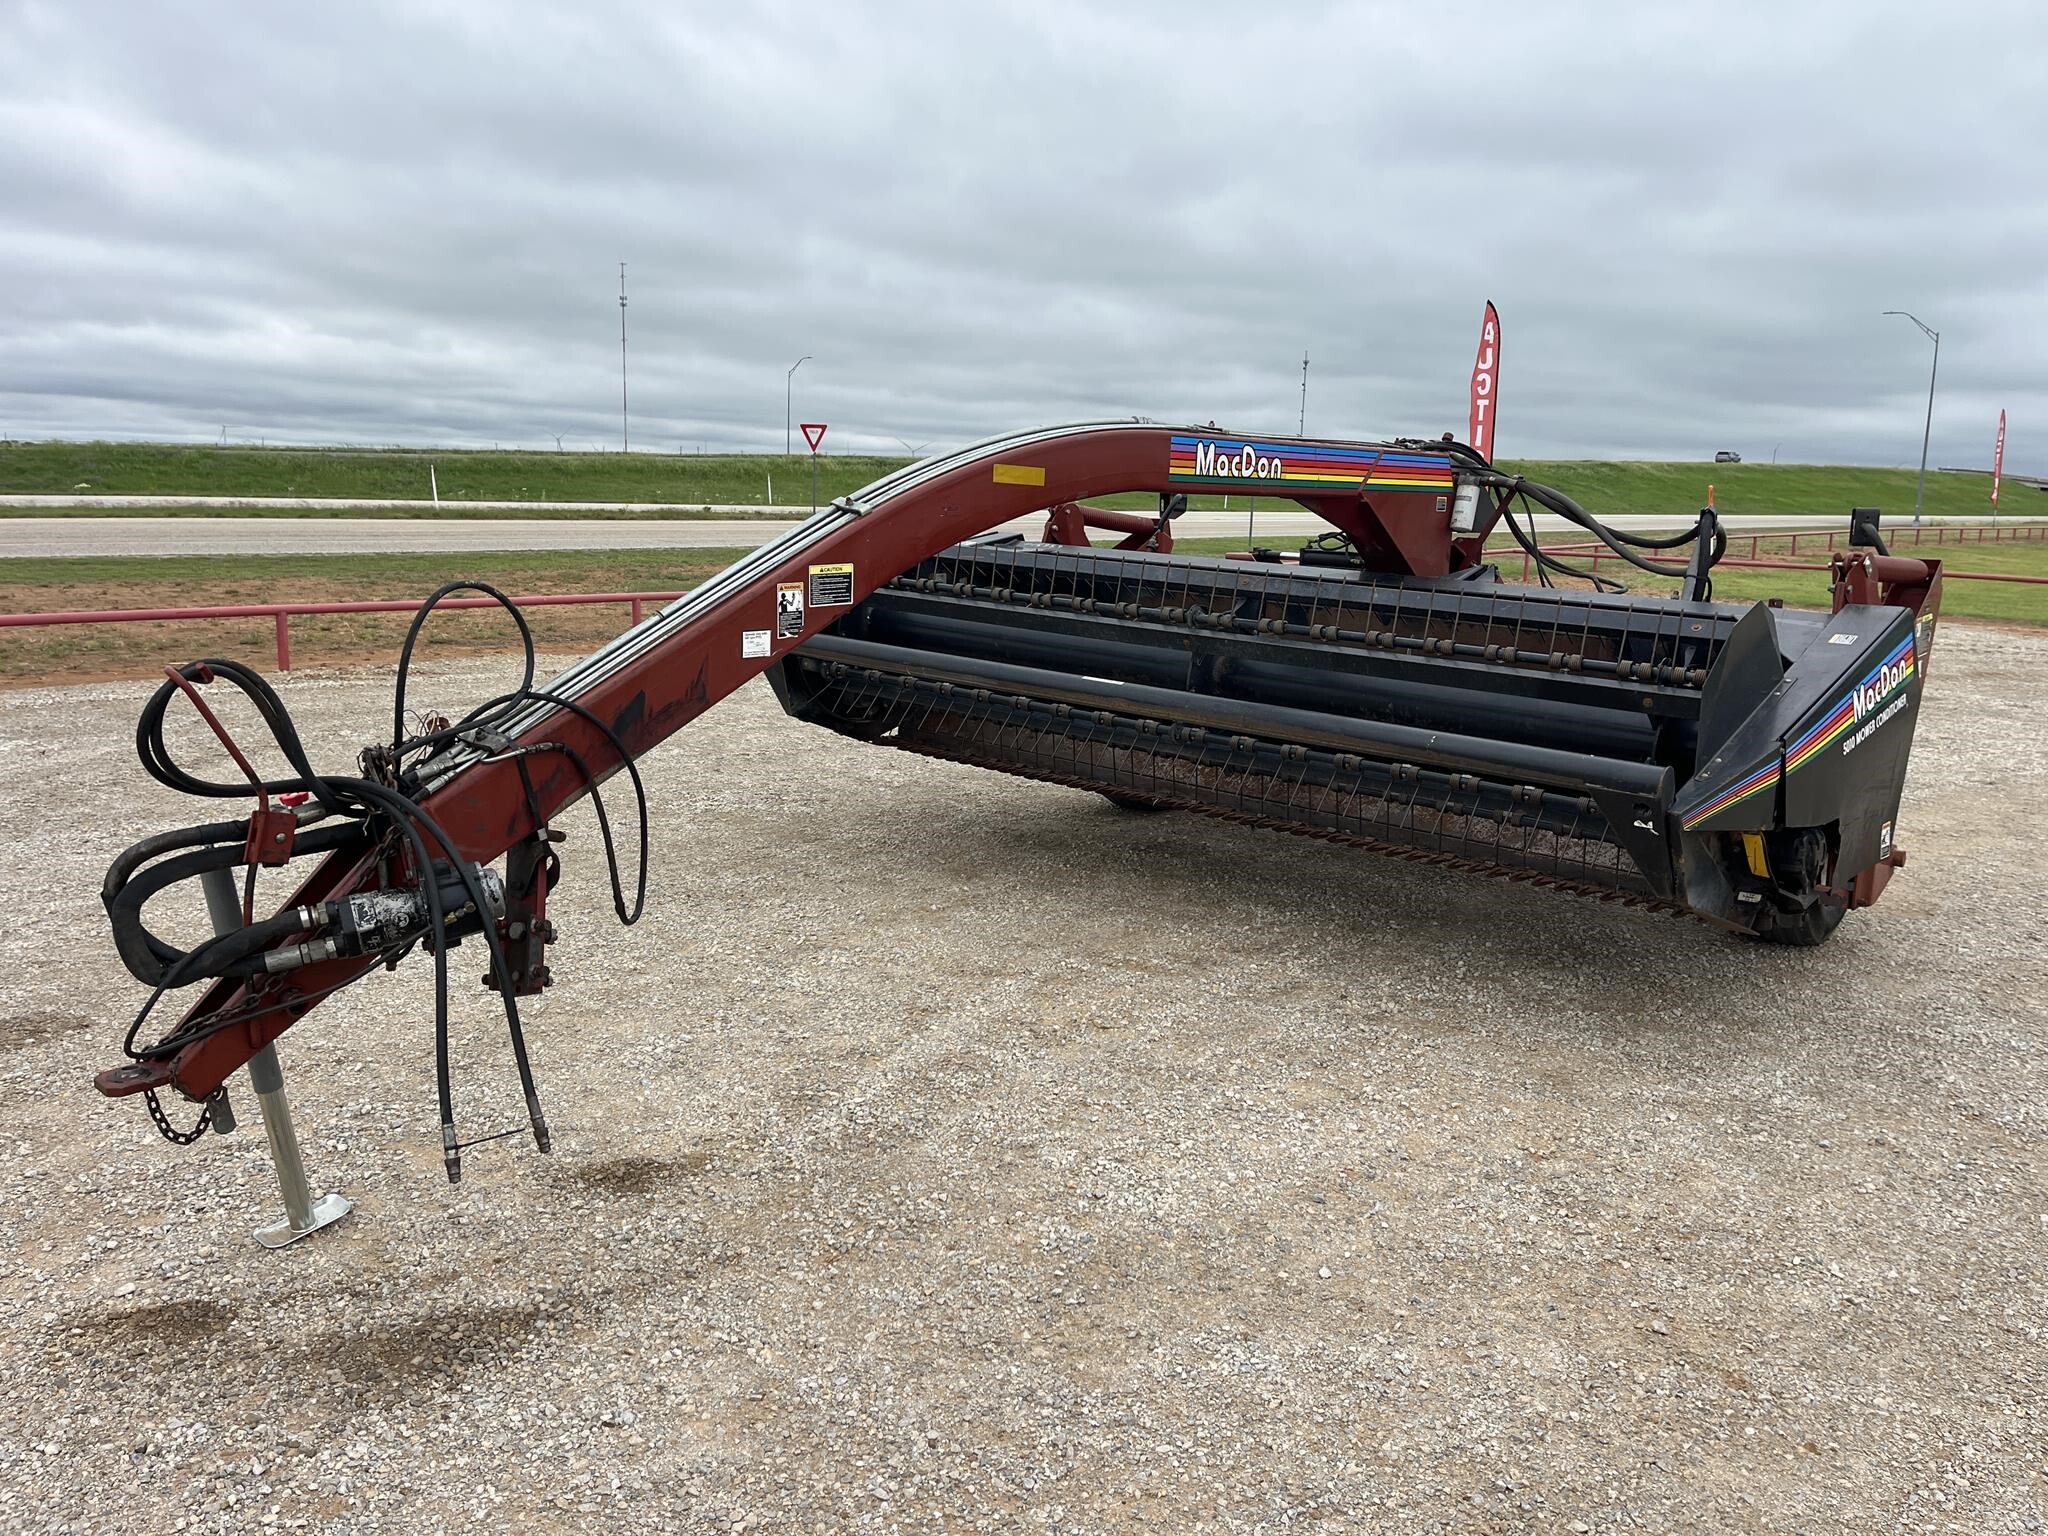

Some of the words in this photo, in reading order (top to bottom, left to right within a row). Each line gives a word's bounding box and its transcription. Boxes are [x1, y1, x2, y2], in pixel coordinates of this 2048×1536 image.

[1195, 441, 1282, 479] MacDon
[1852, 659, 1906, 723] MacDon
[1855, 719, 1876, 746] MOWER
[1875, 693, 1907, 728] CONDITIONER
